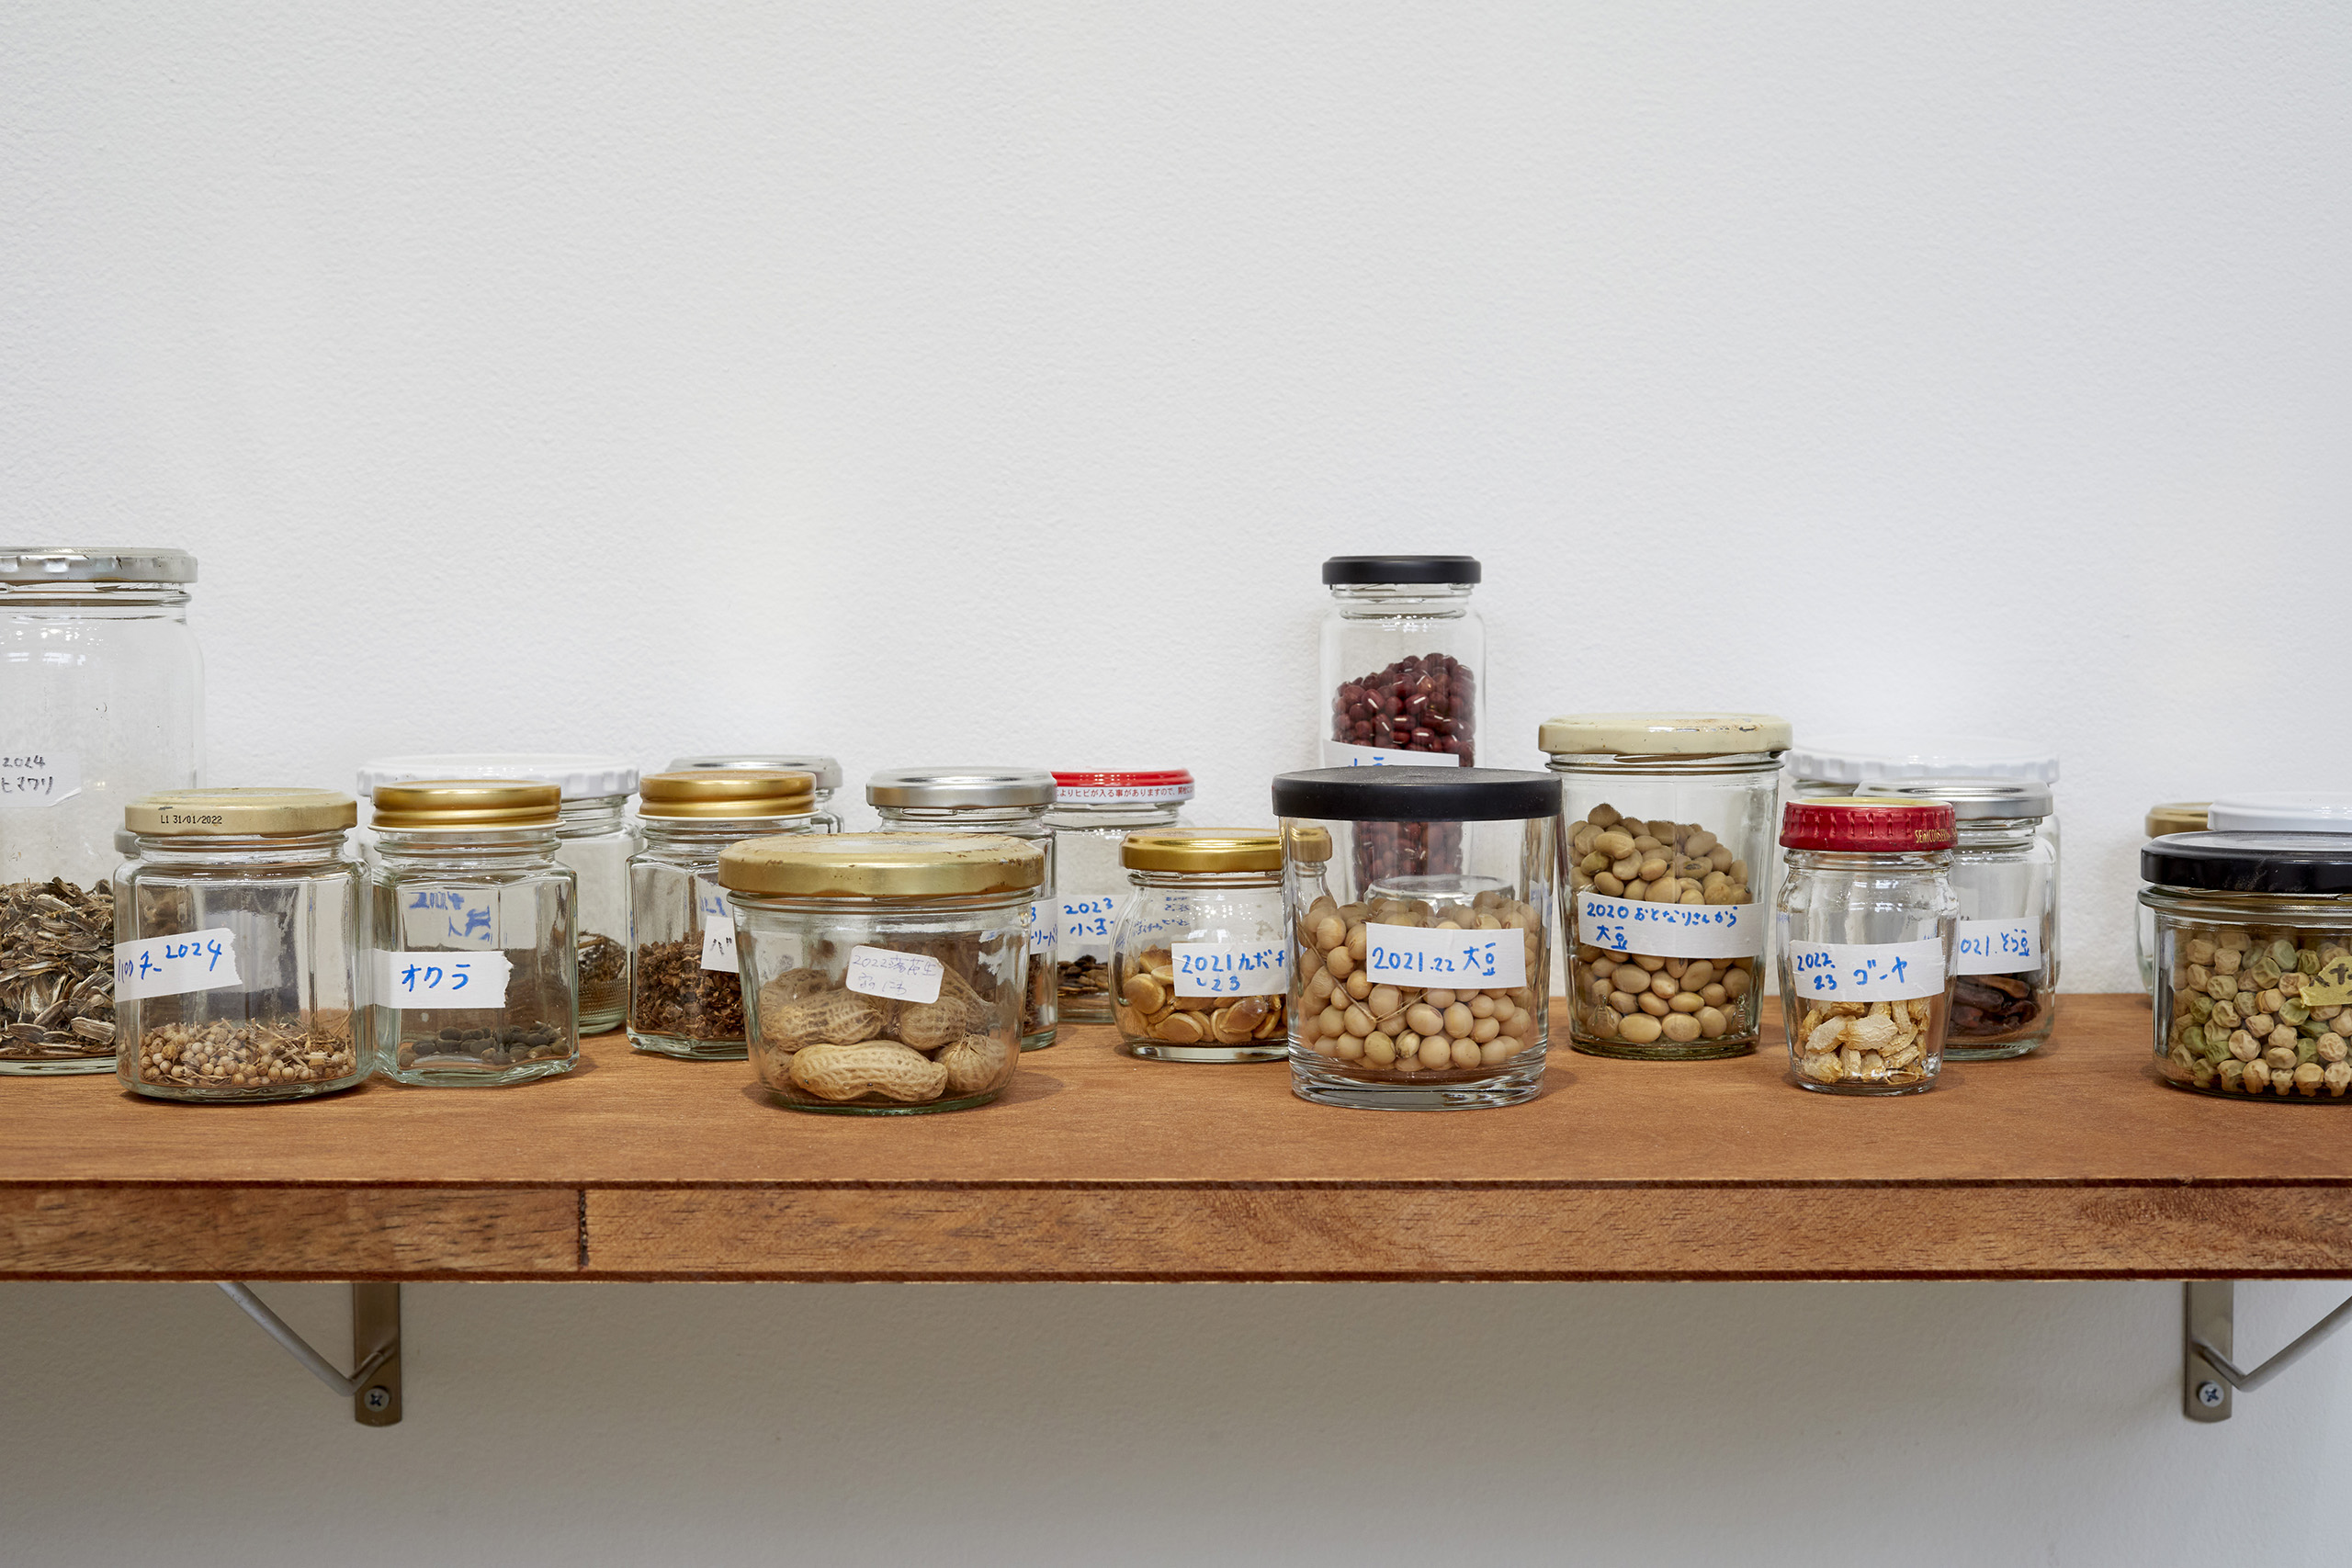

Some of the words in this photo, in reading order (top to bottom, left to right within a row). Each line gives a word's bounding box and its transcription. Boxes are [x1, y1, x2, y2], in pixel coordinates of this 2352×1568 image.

[2, 755, 46, 769] 2024
[1, 776, 53, 795] ヒマワリ
[173, 815, 222, 825] 31/01/2022
[1063, 897, 1114, 915] 2023
[1588, 902, 1629, 919] 2020
[1069, 918, 1114, 937] 小玉
[1596, 924, 1628, 951] 大豆
[165, 939, 222, 972] 2024
[1181, 953, 1232, 975] 2021
[1463, 942, 1497, 976] 大豆
[401, 964, 471, 992] オクラ
[1853, 956, 1908, 985] ゴーヤ
[1814, 974, 1838, 990] 23
